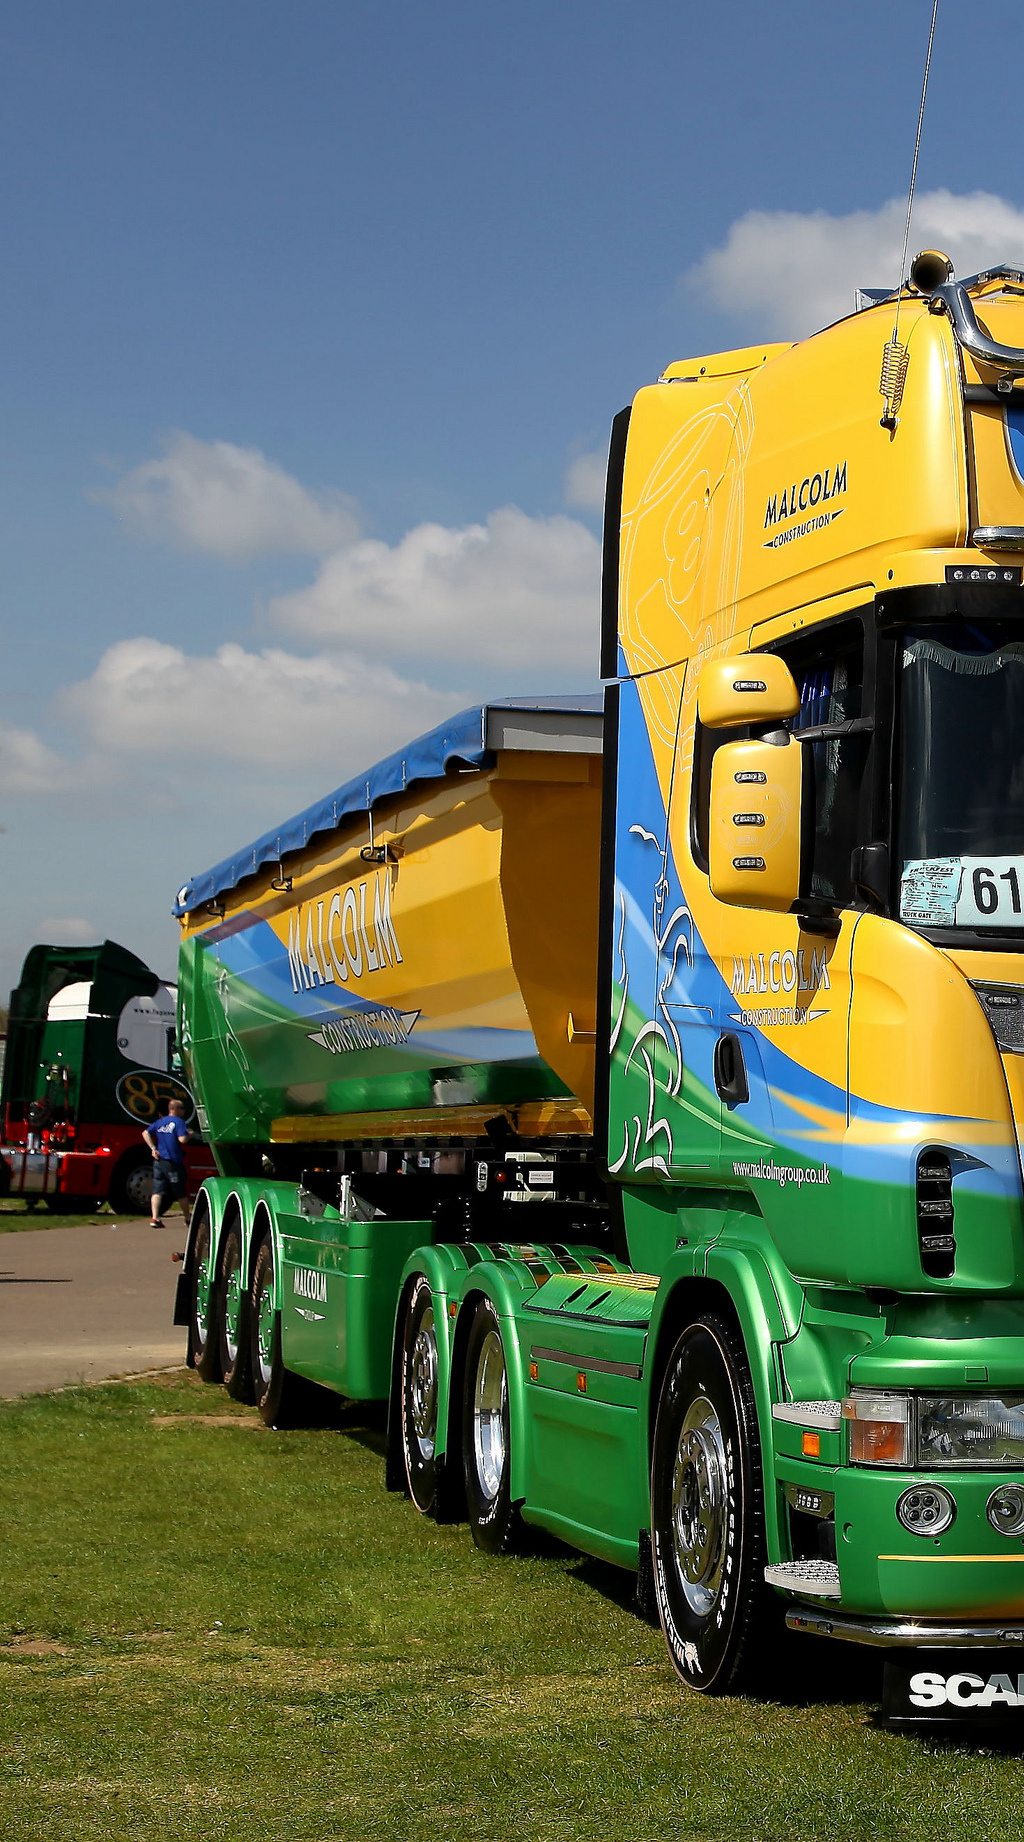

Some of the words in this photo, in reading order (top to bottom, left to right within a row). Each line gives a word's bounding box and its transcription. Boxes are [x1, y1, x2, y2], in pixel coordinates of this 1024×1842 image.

[763, 460, 847, 529] MALCOLM
[773, 513, 831, 548] CONSTRUCTION
[288, 867, 403, 994] MALCOLM
[730, 946, 831, 995] MALCOLM
[321, 1007, 408, 1055] CONSTRUCTION
[741, 1006, 808, 1027] CONSTRUCTION
[732, 1158, 831, 1189] www.malcolmgroup.co.uk
[293, 1266, 328, 1303] MALCOLM
